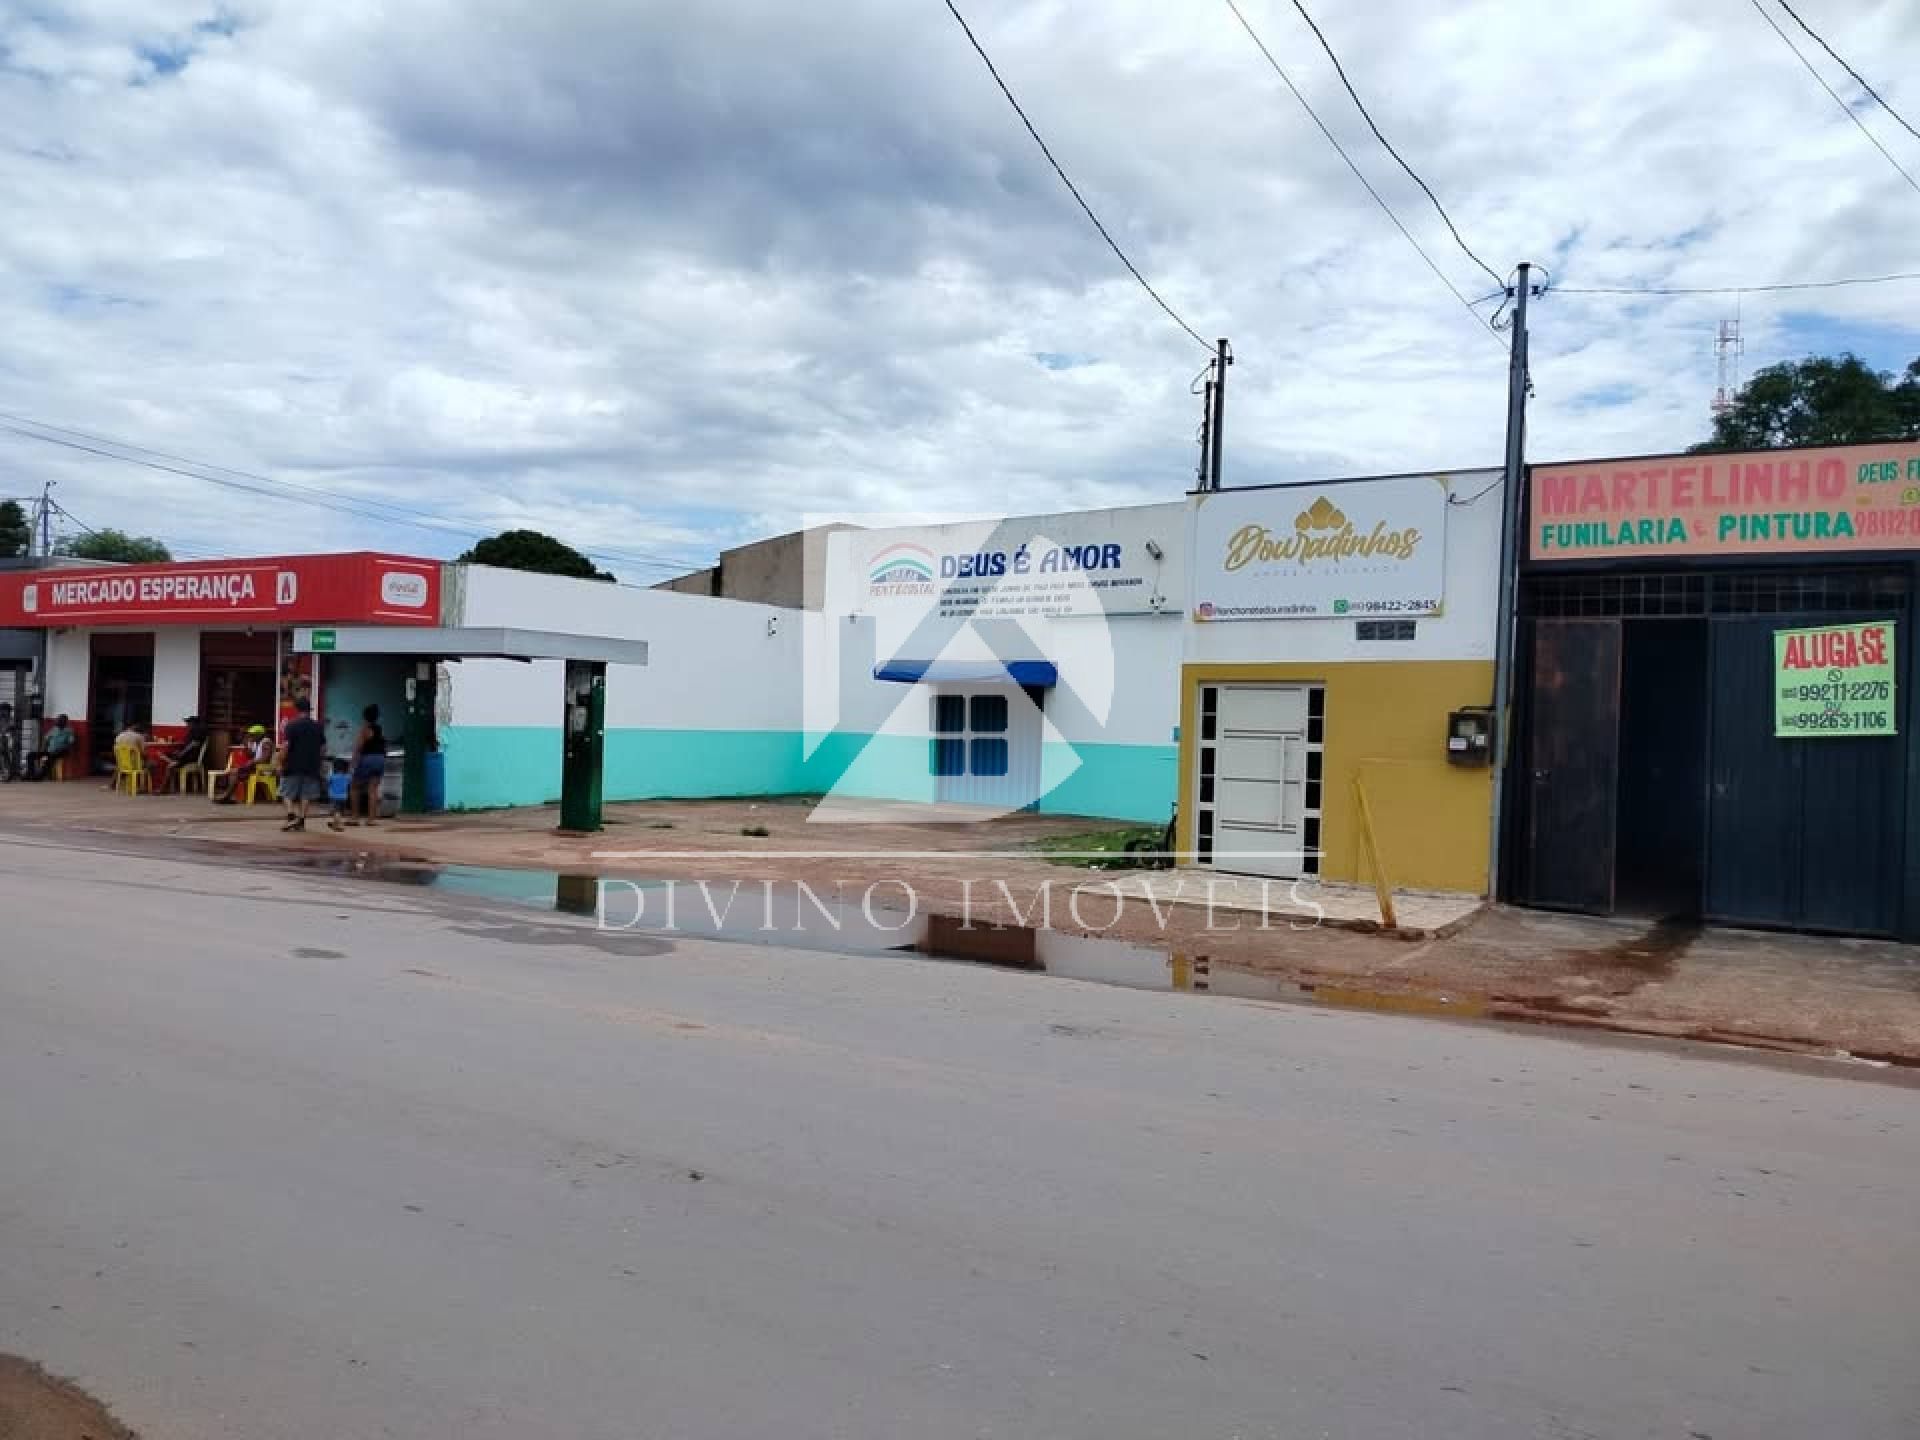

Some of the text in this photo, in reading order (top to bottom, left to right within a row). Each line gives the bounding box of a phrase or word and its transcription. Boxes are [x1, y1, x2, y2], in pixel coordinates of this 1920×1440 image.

[1541, 458, 1847, 514] MARTELINHO
[1857, 461, 1898, 484] DEUS
[1224, 518, 1423, 571] Douradinhos
[1541, 516, 1688, 549] FUNILARIA
[1717, 511, 1855, 543] PINTURA
[941, 552, 1006, 578] DEUS
[1013, 543, 1032, 574] É
[1039, 543, 1122, 573] AMOR
[52, 574, 255, 606] MERCADO ESPERANÇA
[1783, 627, 1889, 670] ALUGA-SE
[1799, 681, 1890, 701] 99211-2276
[1797, 711, 1887, 728] 99263-1106
